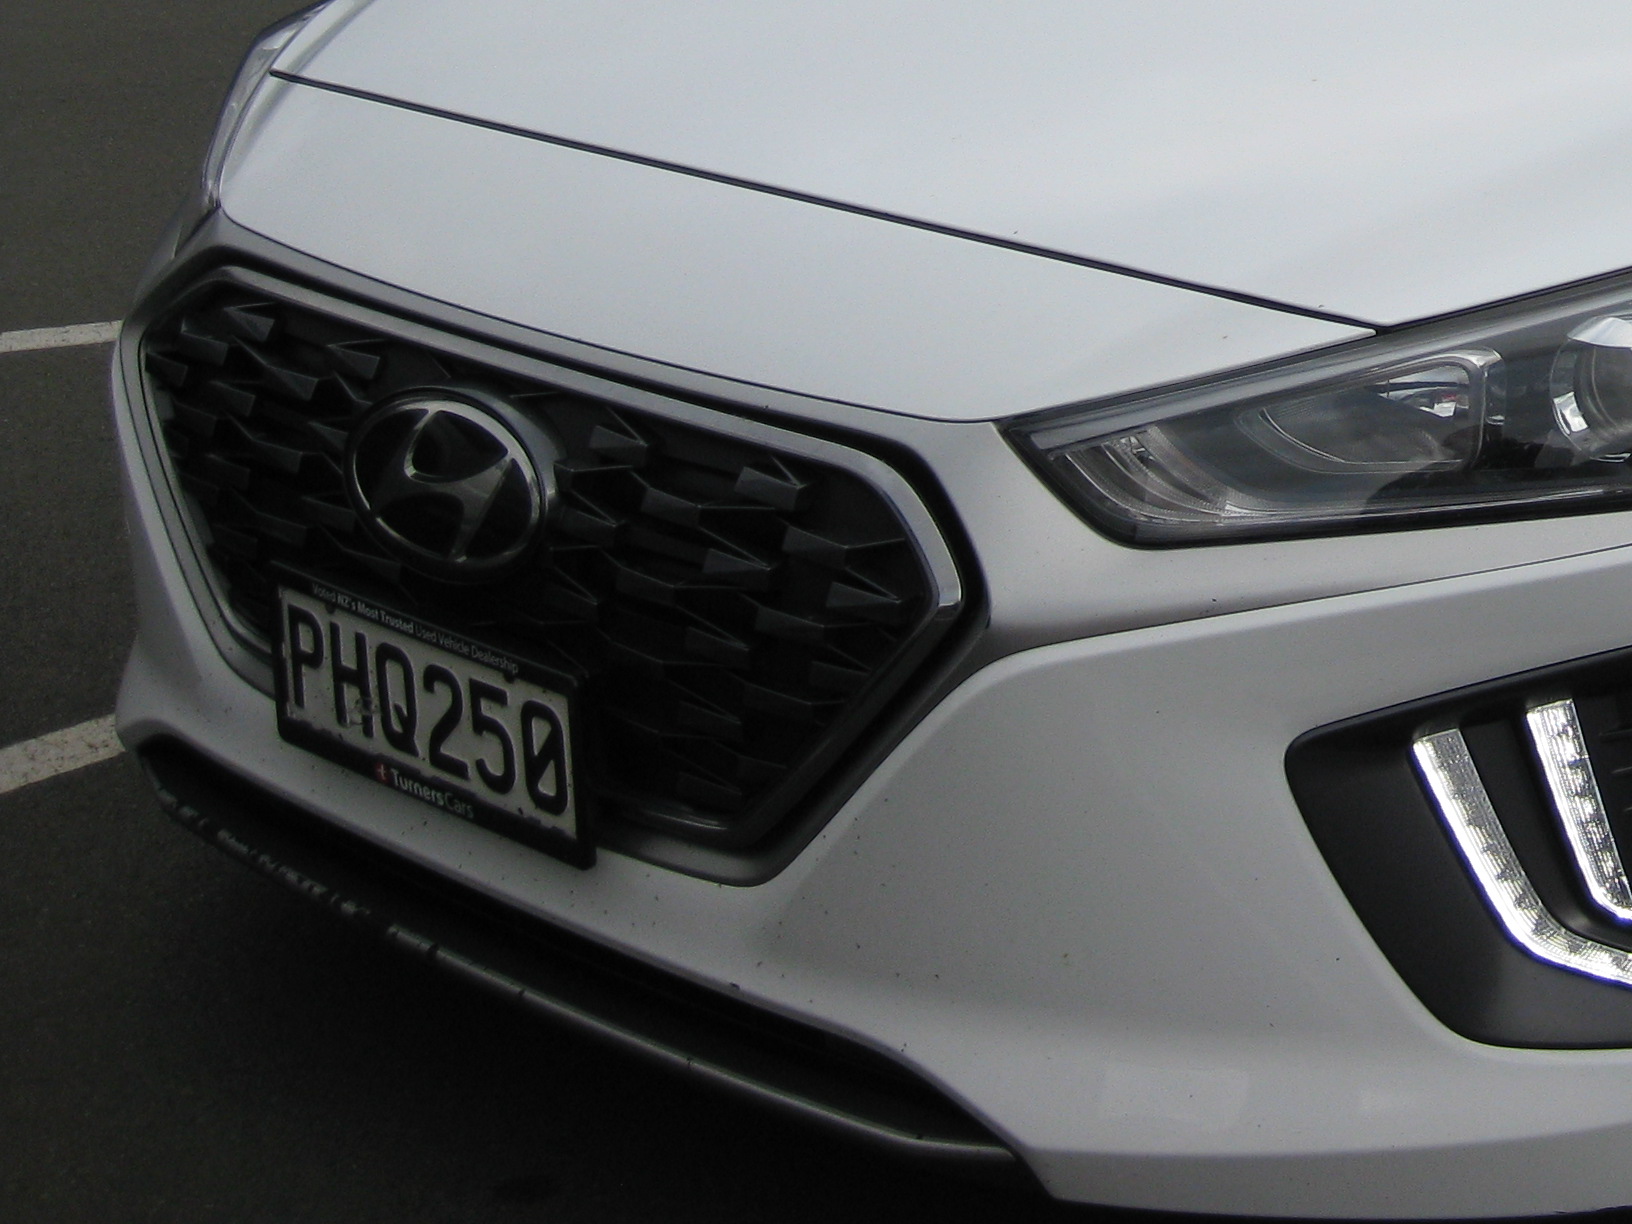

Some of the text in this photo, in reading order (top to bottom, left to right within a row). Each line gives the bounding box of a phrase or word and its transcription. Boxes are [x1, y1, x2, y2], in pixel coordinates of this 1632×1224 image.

[312, 582, 336, 603] Voted
[357, 599, 379, 620] Most
[380, 606, 414, 636] Trusted
[415, 622, 437, 642] Used
[438, 632, 471, 657] Vehicle
[471, 643, 520, 675] Dealership
[287, 603, 569, 817] PHQ250
